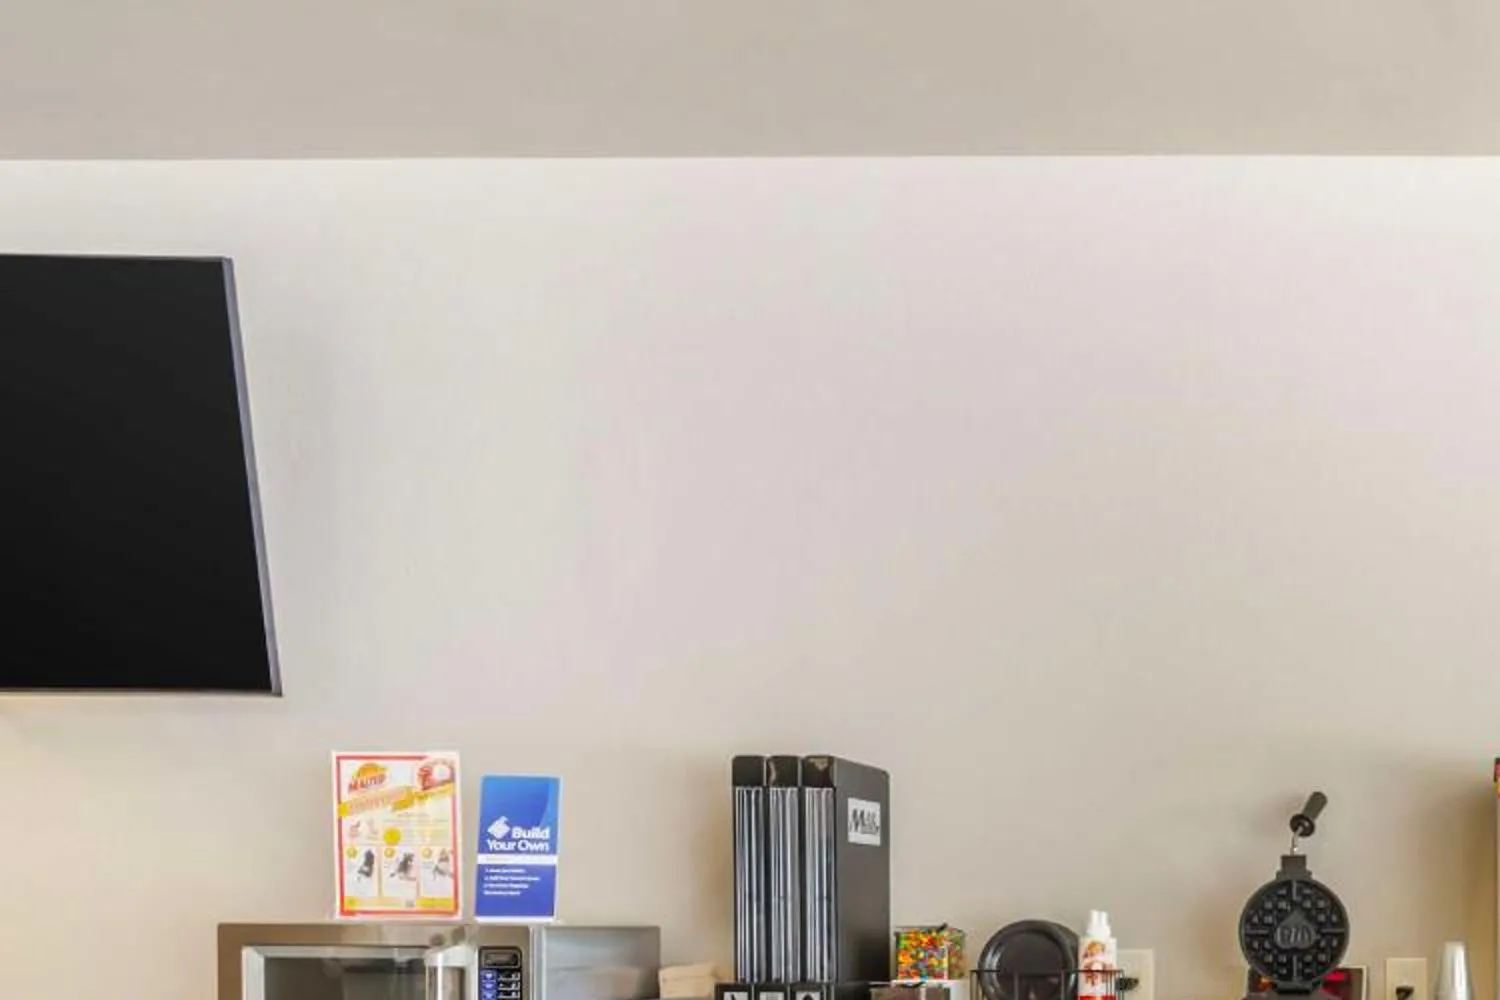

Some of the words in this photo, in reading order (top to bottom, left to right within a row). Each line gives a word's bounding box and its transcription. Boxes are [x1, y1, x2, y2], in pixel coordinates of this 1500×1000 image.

[512, 826, 550, 839] Build
[487, 839, 516, 851] Your
[517, 839, 549, 852] Own
